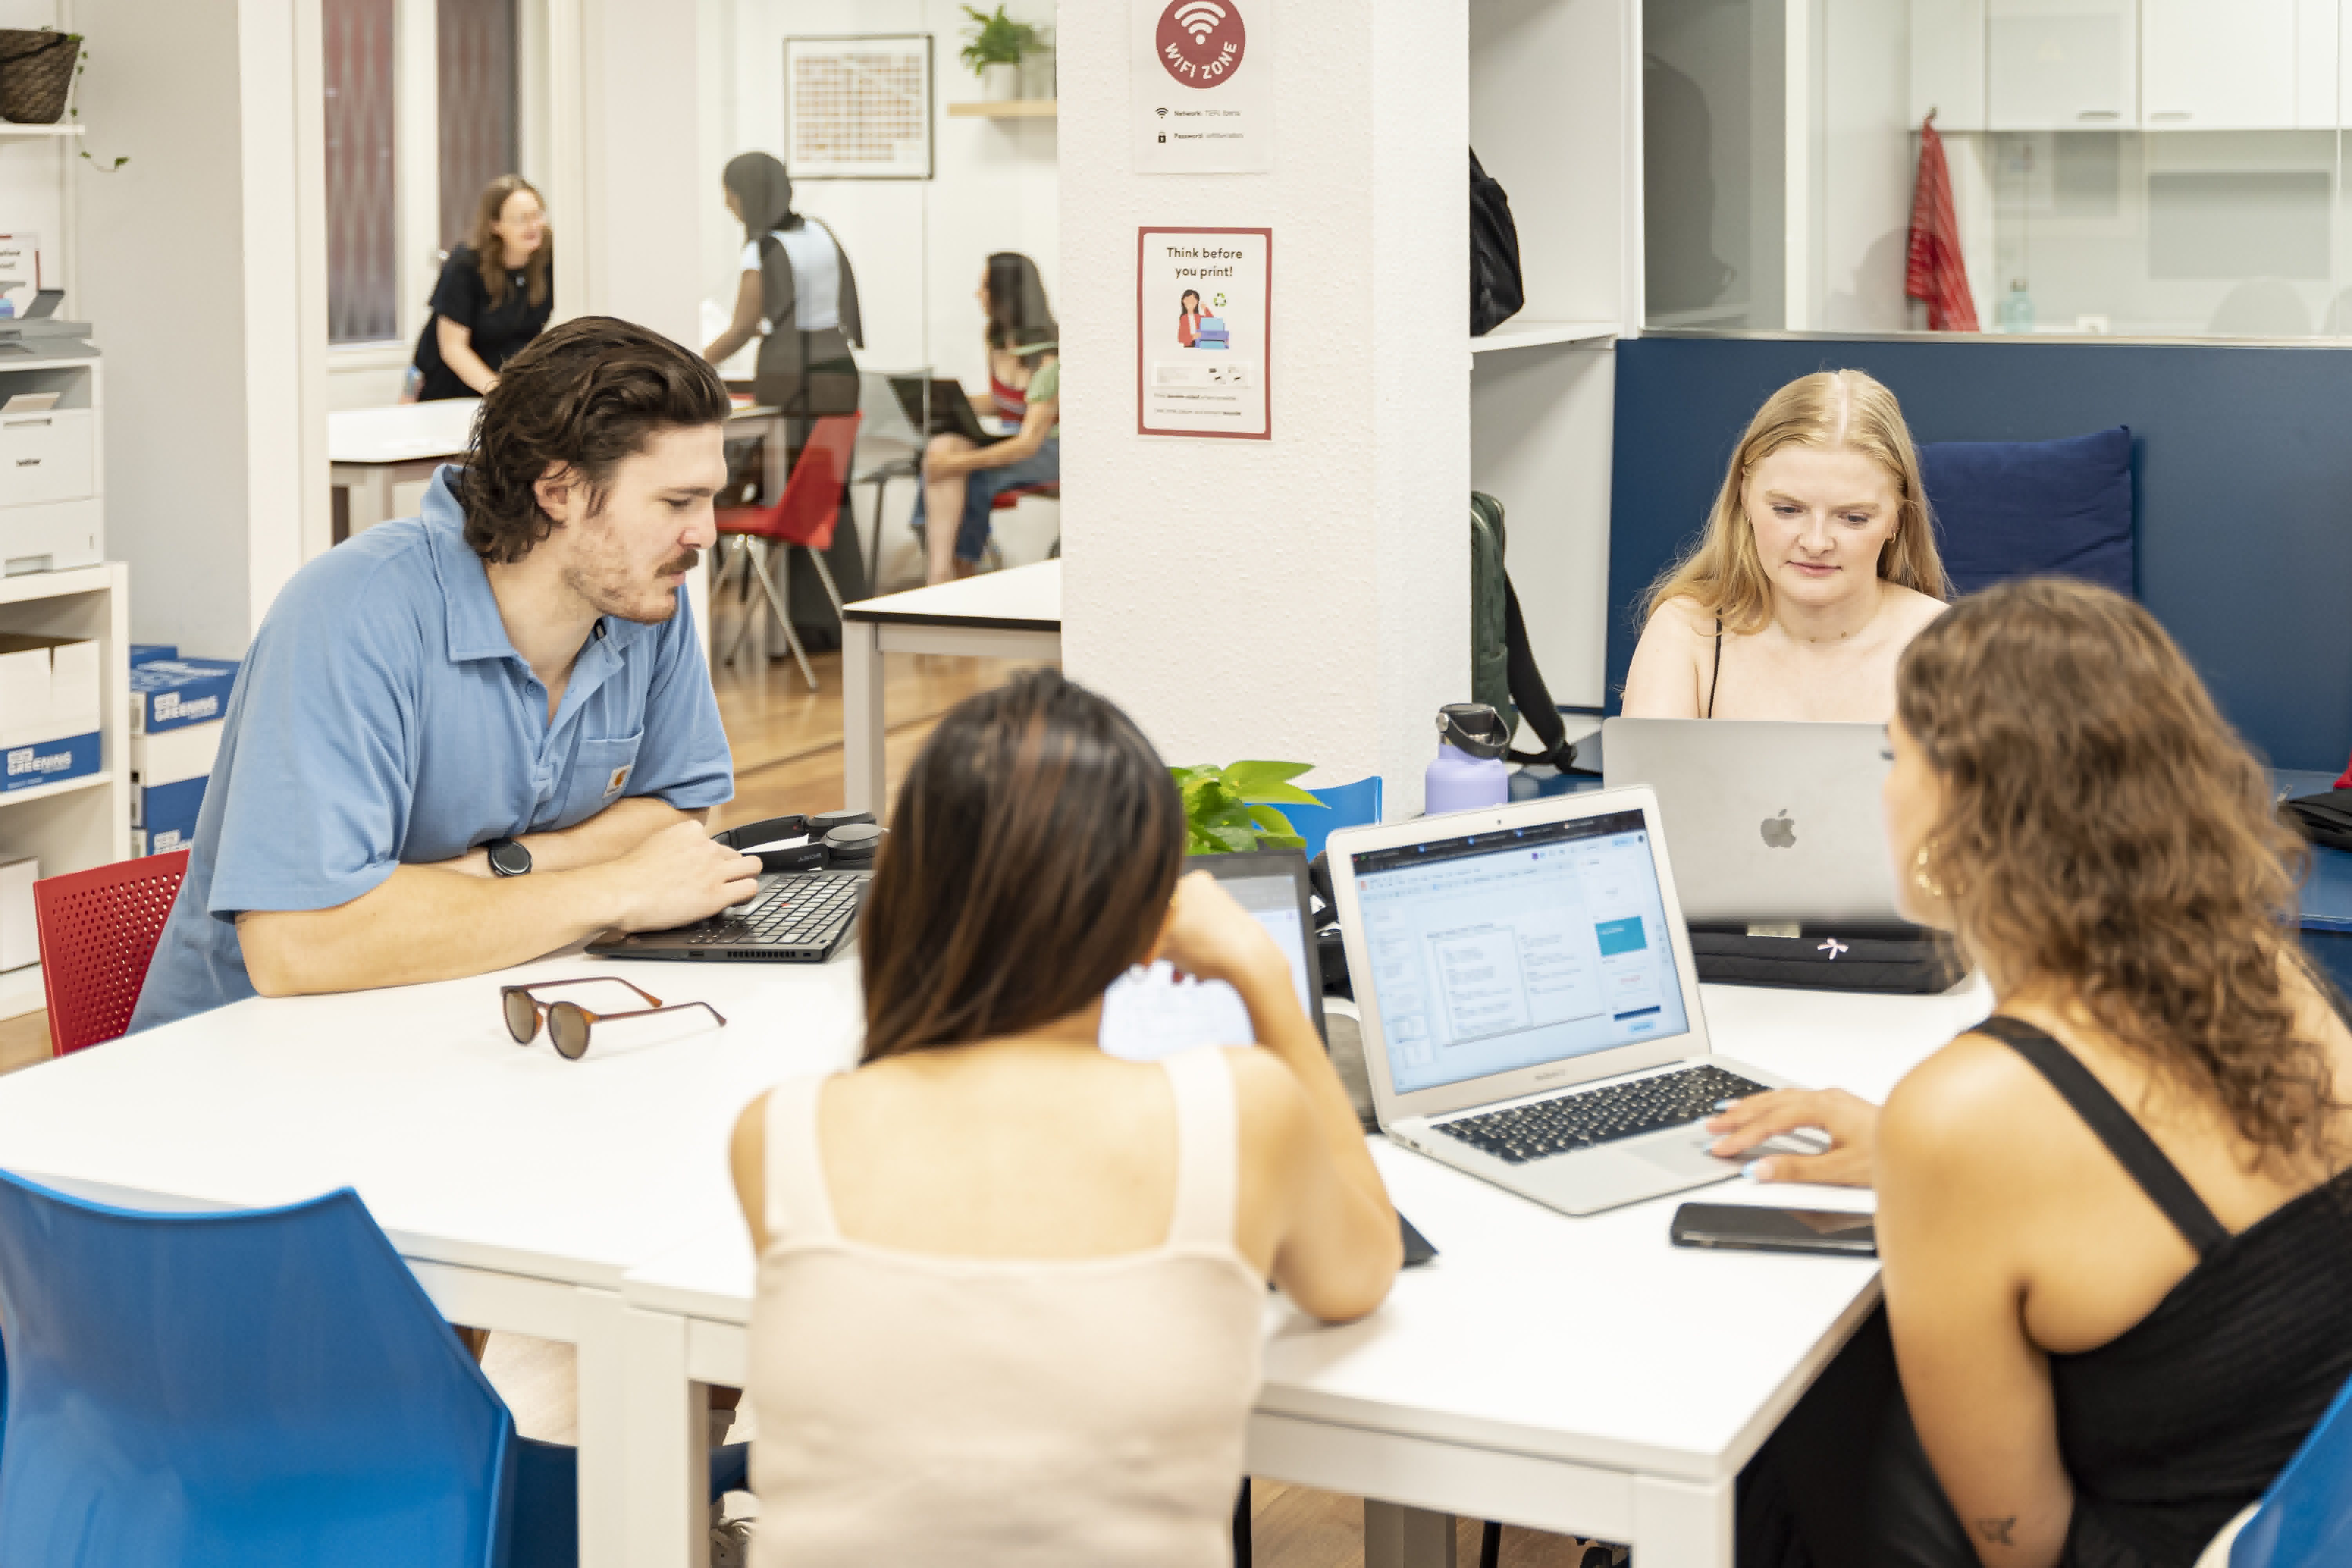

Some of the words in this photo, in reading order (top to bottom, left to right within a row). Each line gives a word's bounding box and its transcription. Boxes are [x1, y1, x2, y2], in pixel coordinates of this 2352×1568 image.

[1165, 42, 1196, 78] WIFI
[1201, 41, 1237, 79] ZONE
[1167, 247, 1198, 258] Think
[1203, 247, 1242, 259] before
[1176, 268, 1196, 279] you
[1200, 265, 1233, 279] print!
